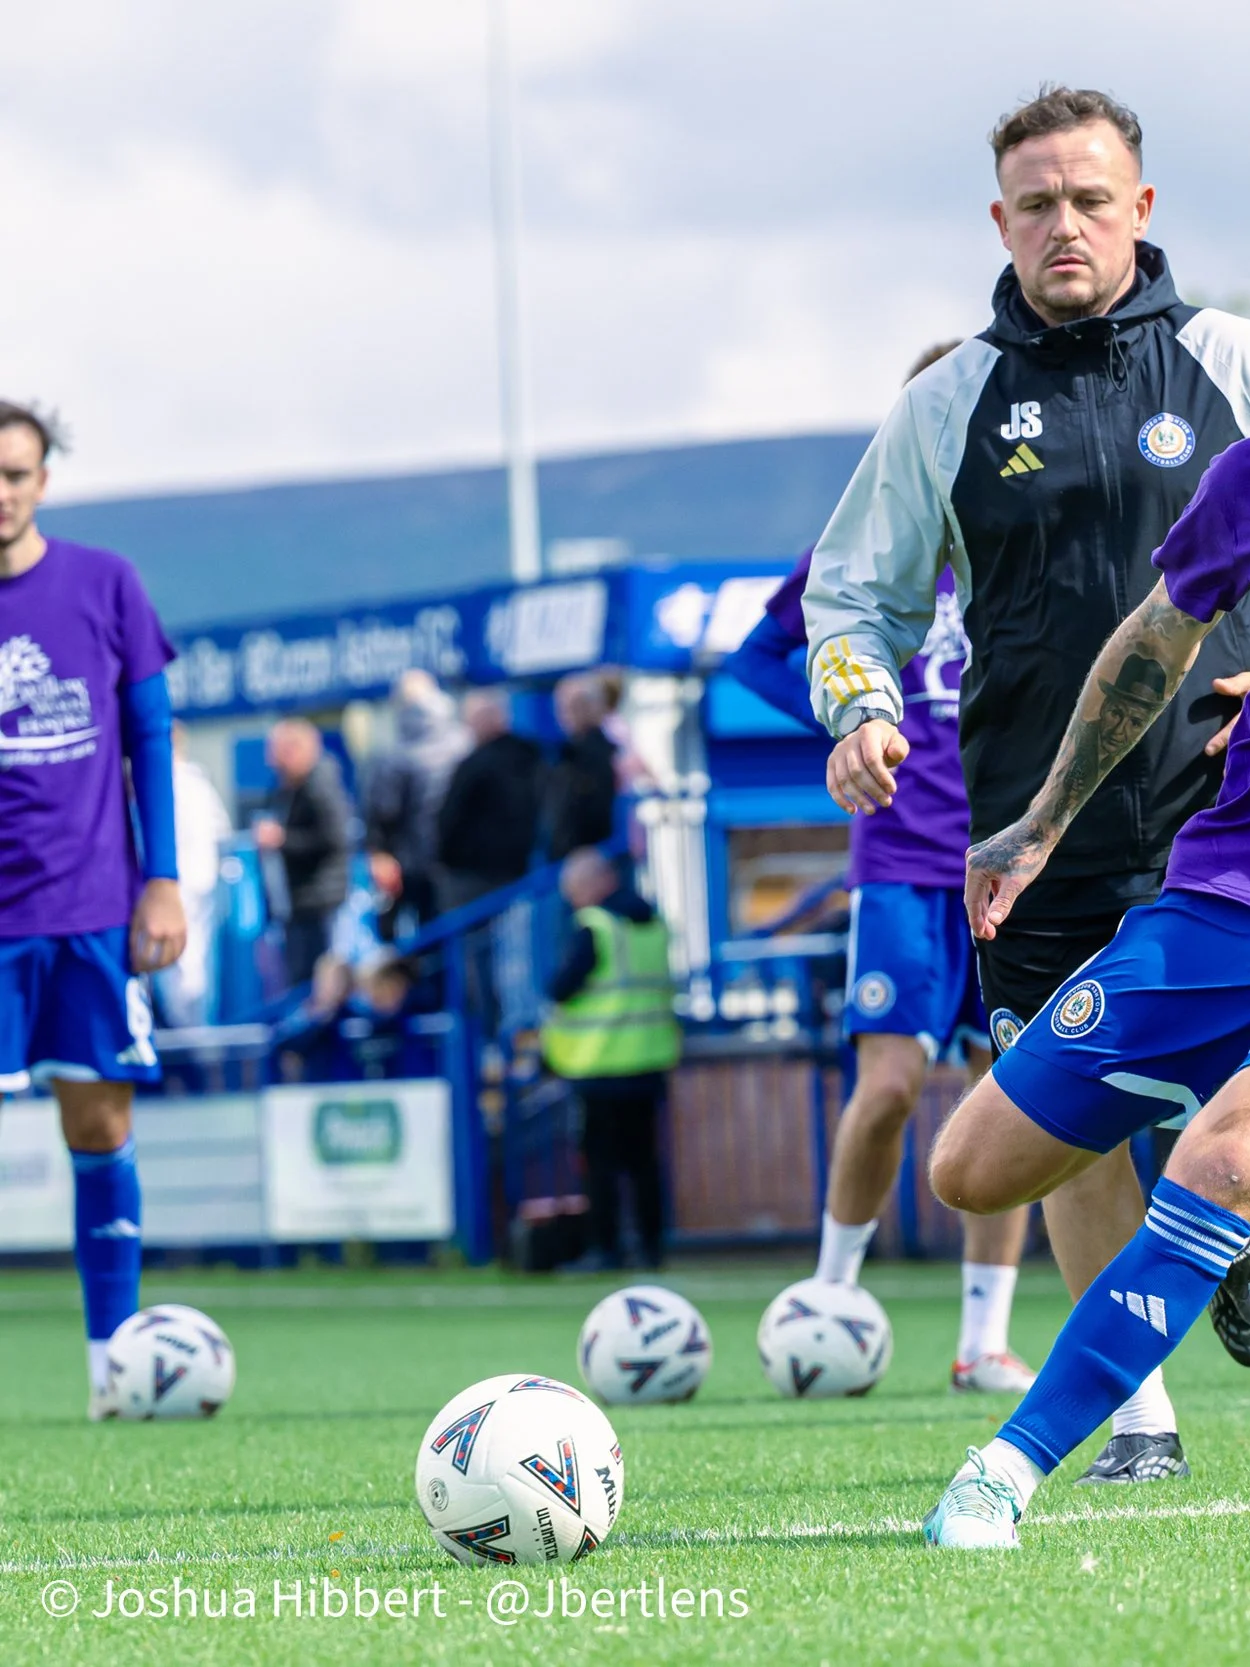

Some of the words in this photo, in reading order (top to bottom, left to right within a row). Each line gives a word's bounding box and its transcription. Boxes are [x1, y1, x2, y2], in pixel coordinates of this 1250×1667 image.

[1000, 401, 1043, 440] JS
[1144, 448, 1179, 465] FOOTBALL
[1179, 444, 1193, 461] CLUB
[1092, 985, 1102, 1013] ASHTON
[1070, 1023, 1089, 1034] CLUB
